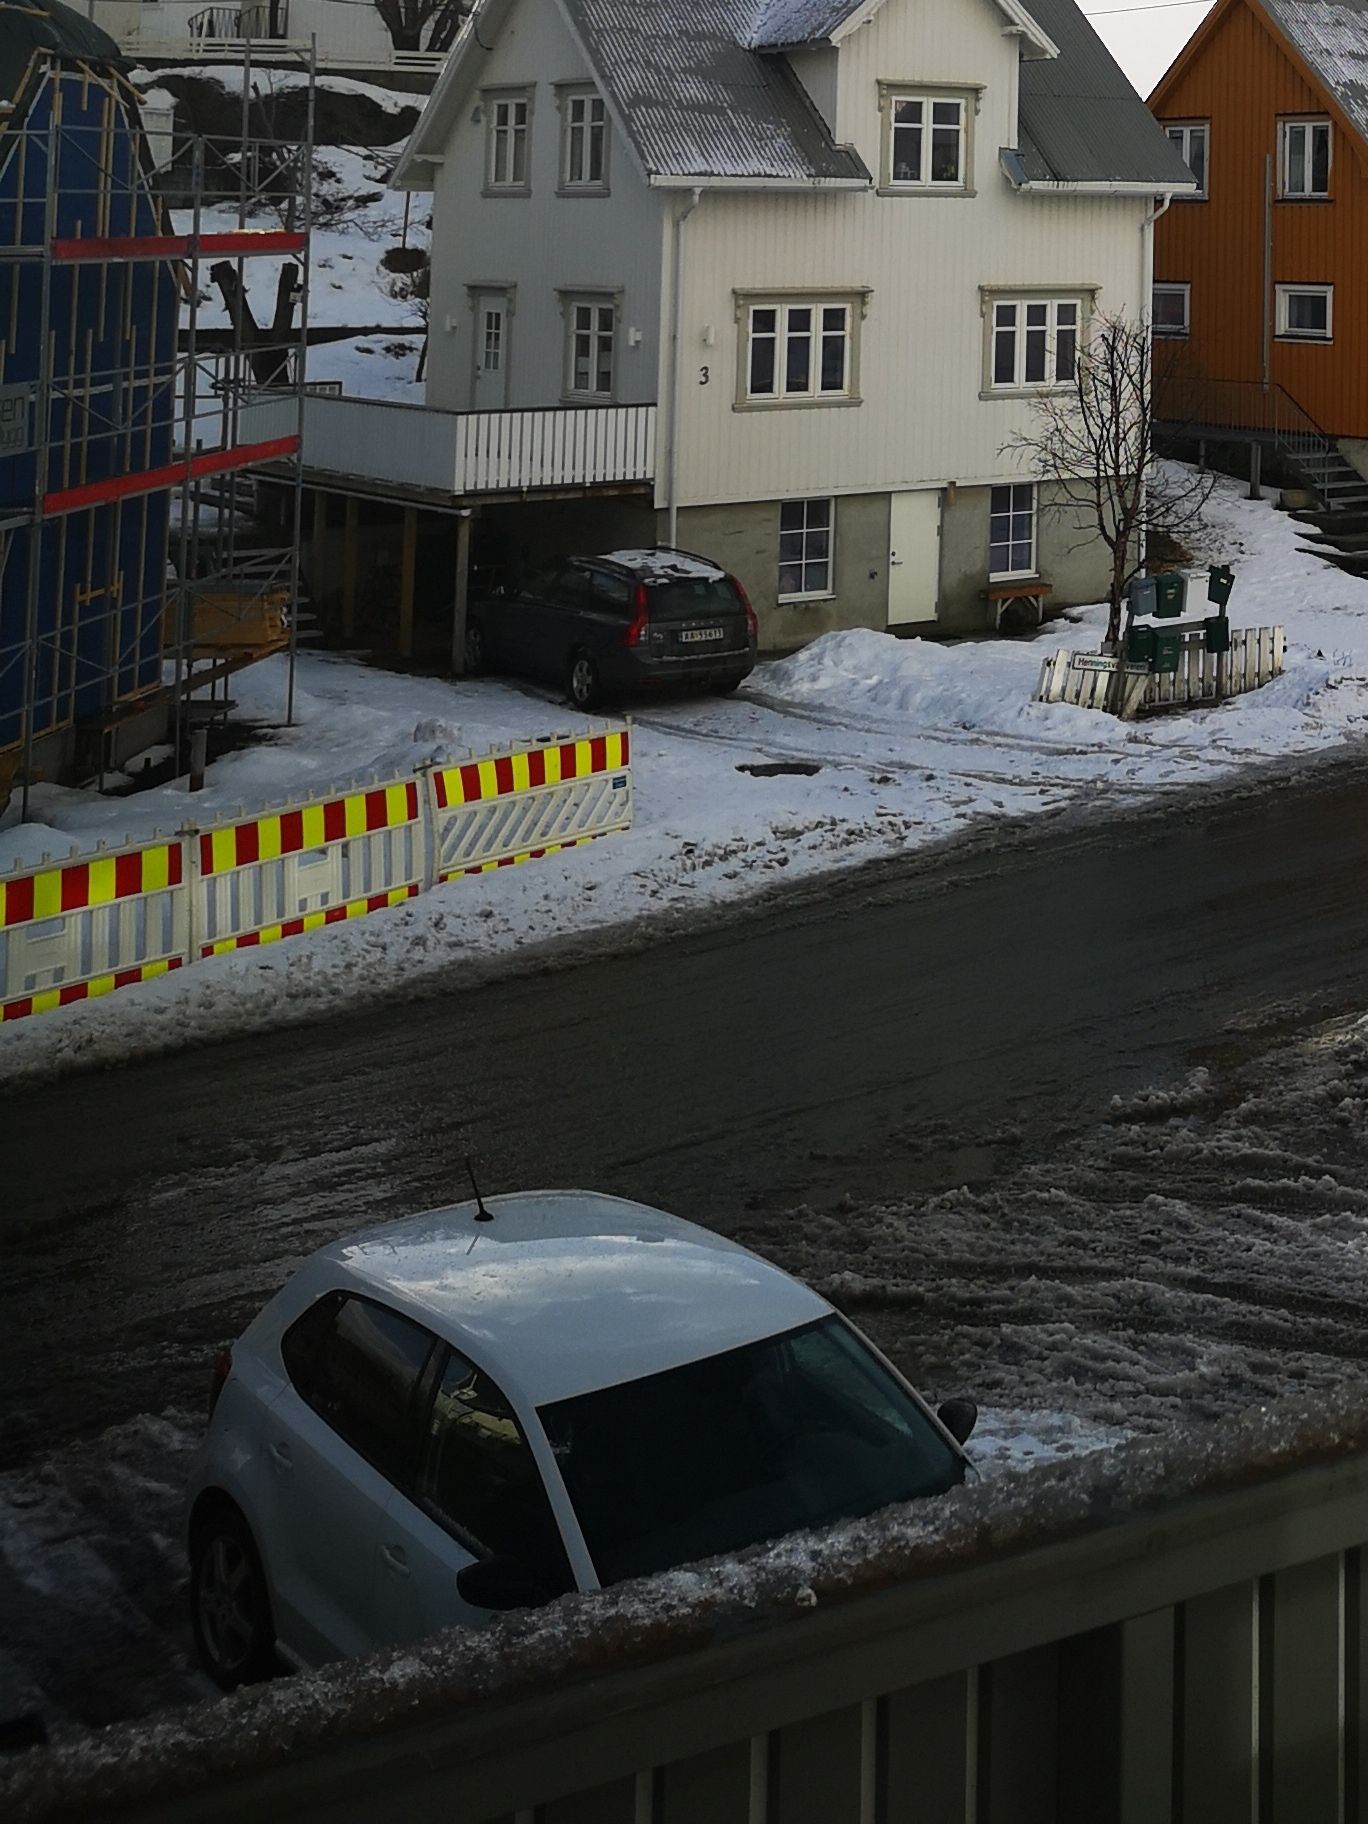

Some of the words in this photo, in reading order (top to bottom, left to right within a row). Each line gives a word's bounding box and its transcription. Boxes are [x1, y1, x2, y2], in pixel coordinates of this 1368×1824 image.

[699, 366, 709, 385] 3
[0, 397, 24, 422] en
[1078, 657, 1146, 672] Henningsvveien
